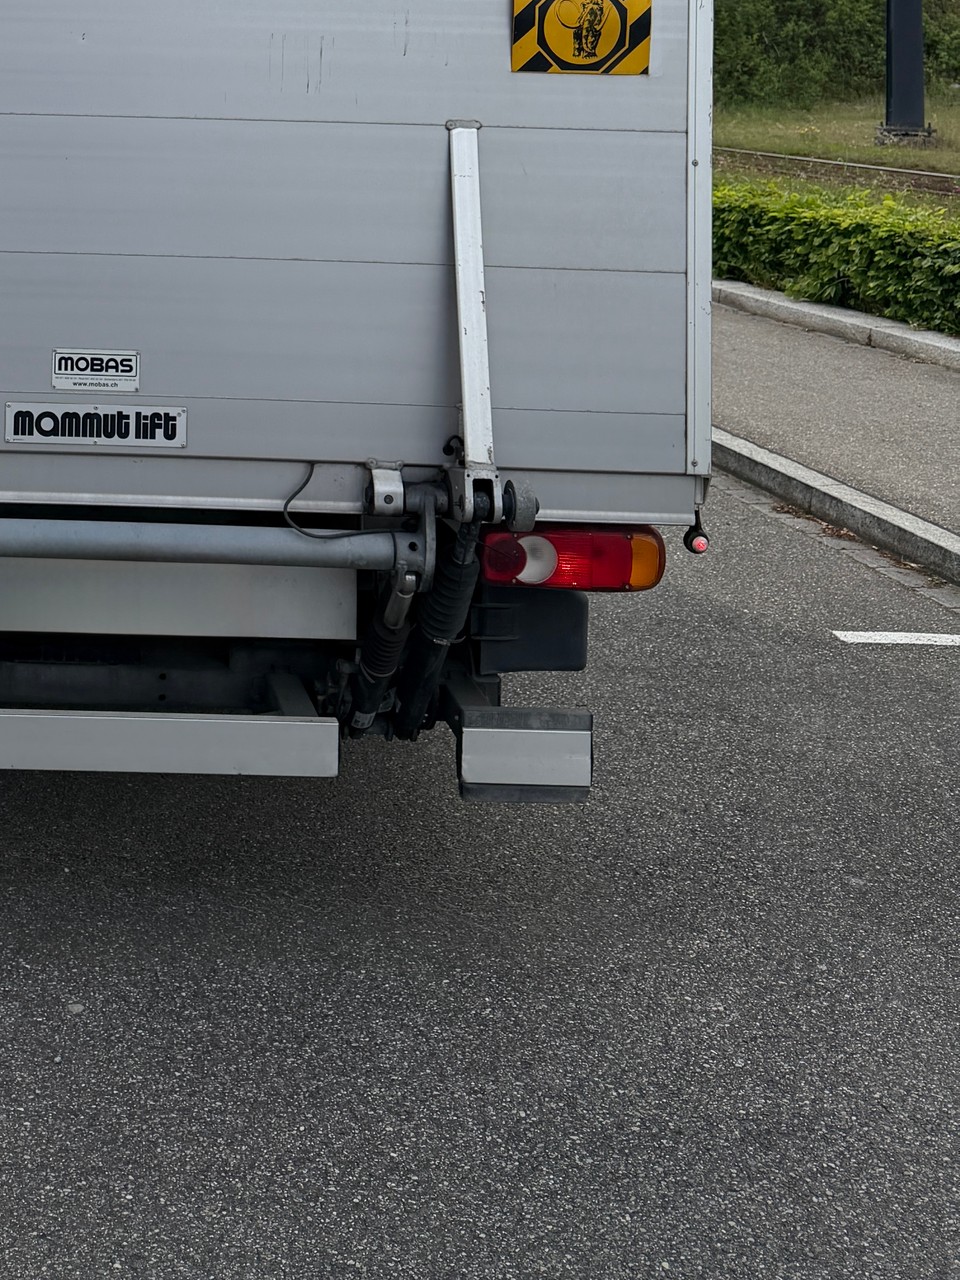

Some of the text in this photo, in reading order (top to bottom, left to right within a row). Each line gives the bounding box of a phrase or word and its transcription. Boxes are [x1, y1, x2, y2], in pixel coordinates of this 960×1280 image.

[57, 356, 134, 373] MOBAS
[13, 410, 177, 440] mammut lift
